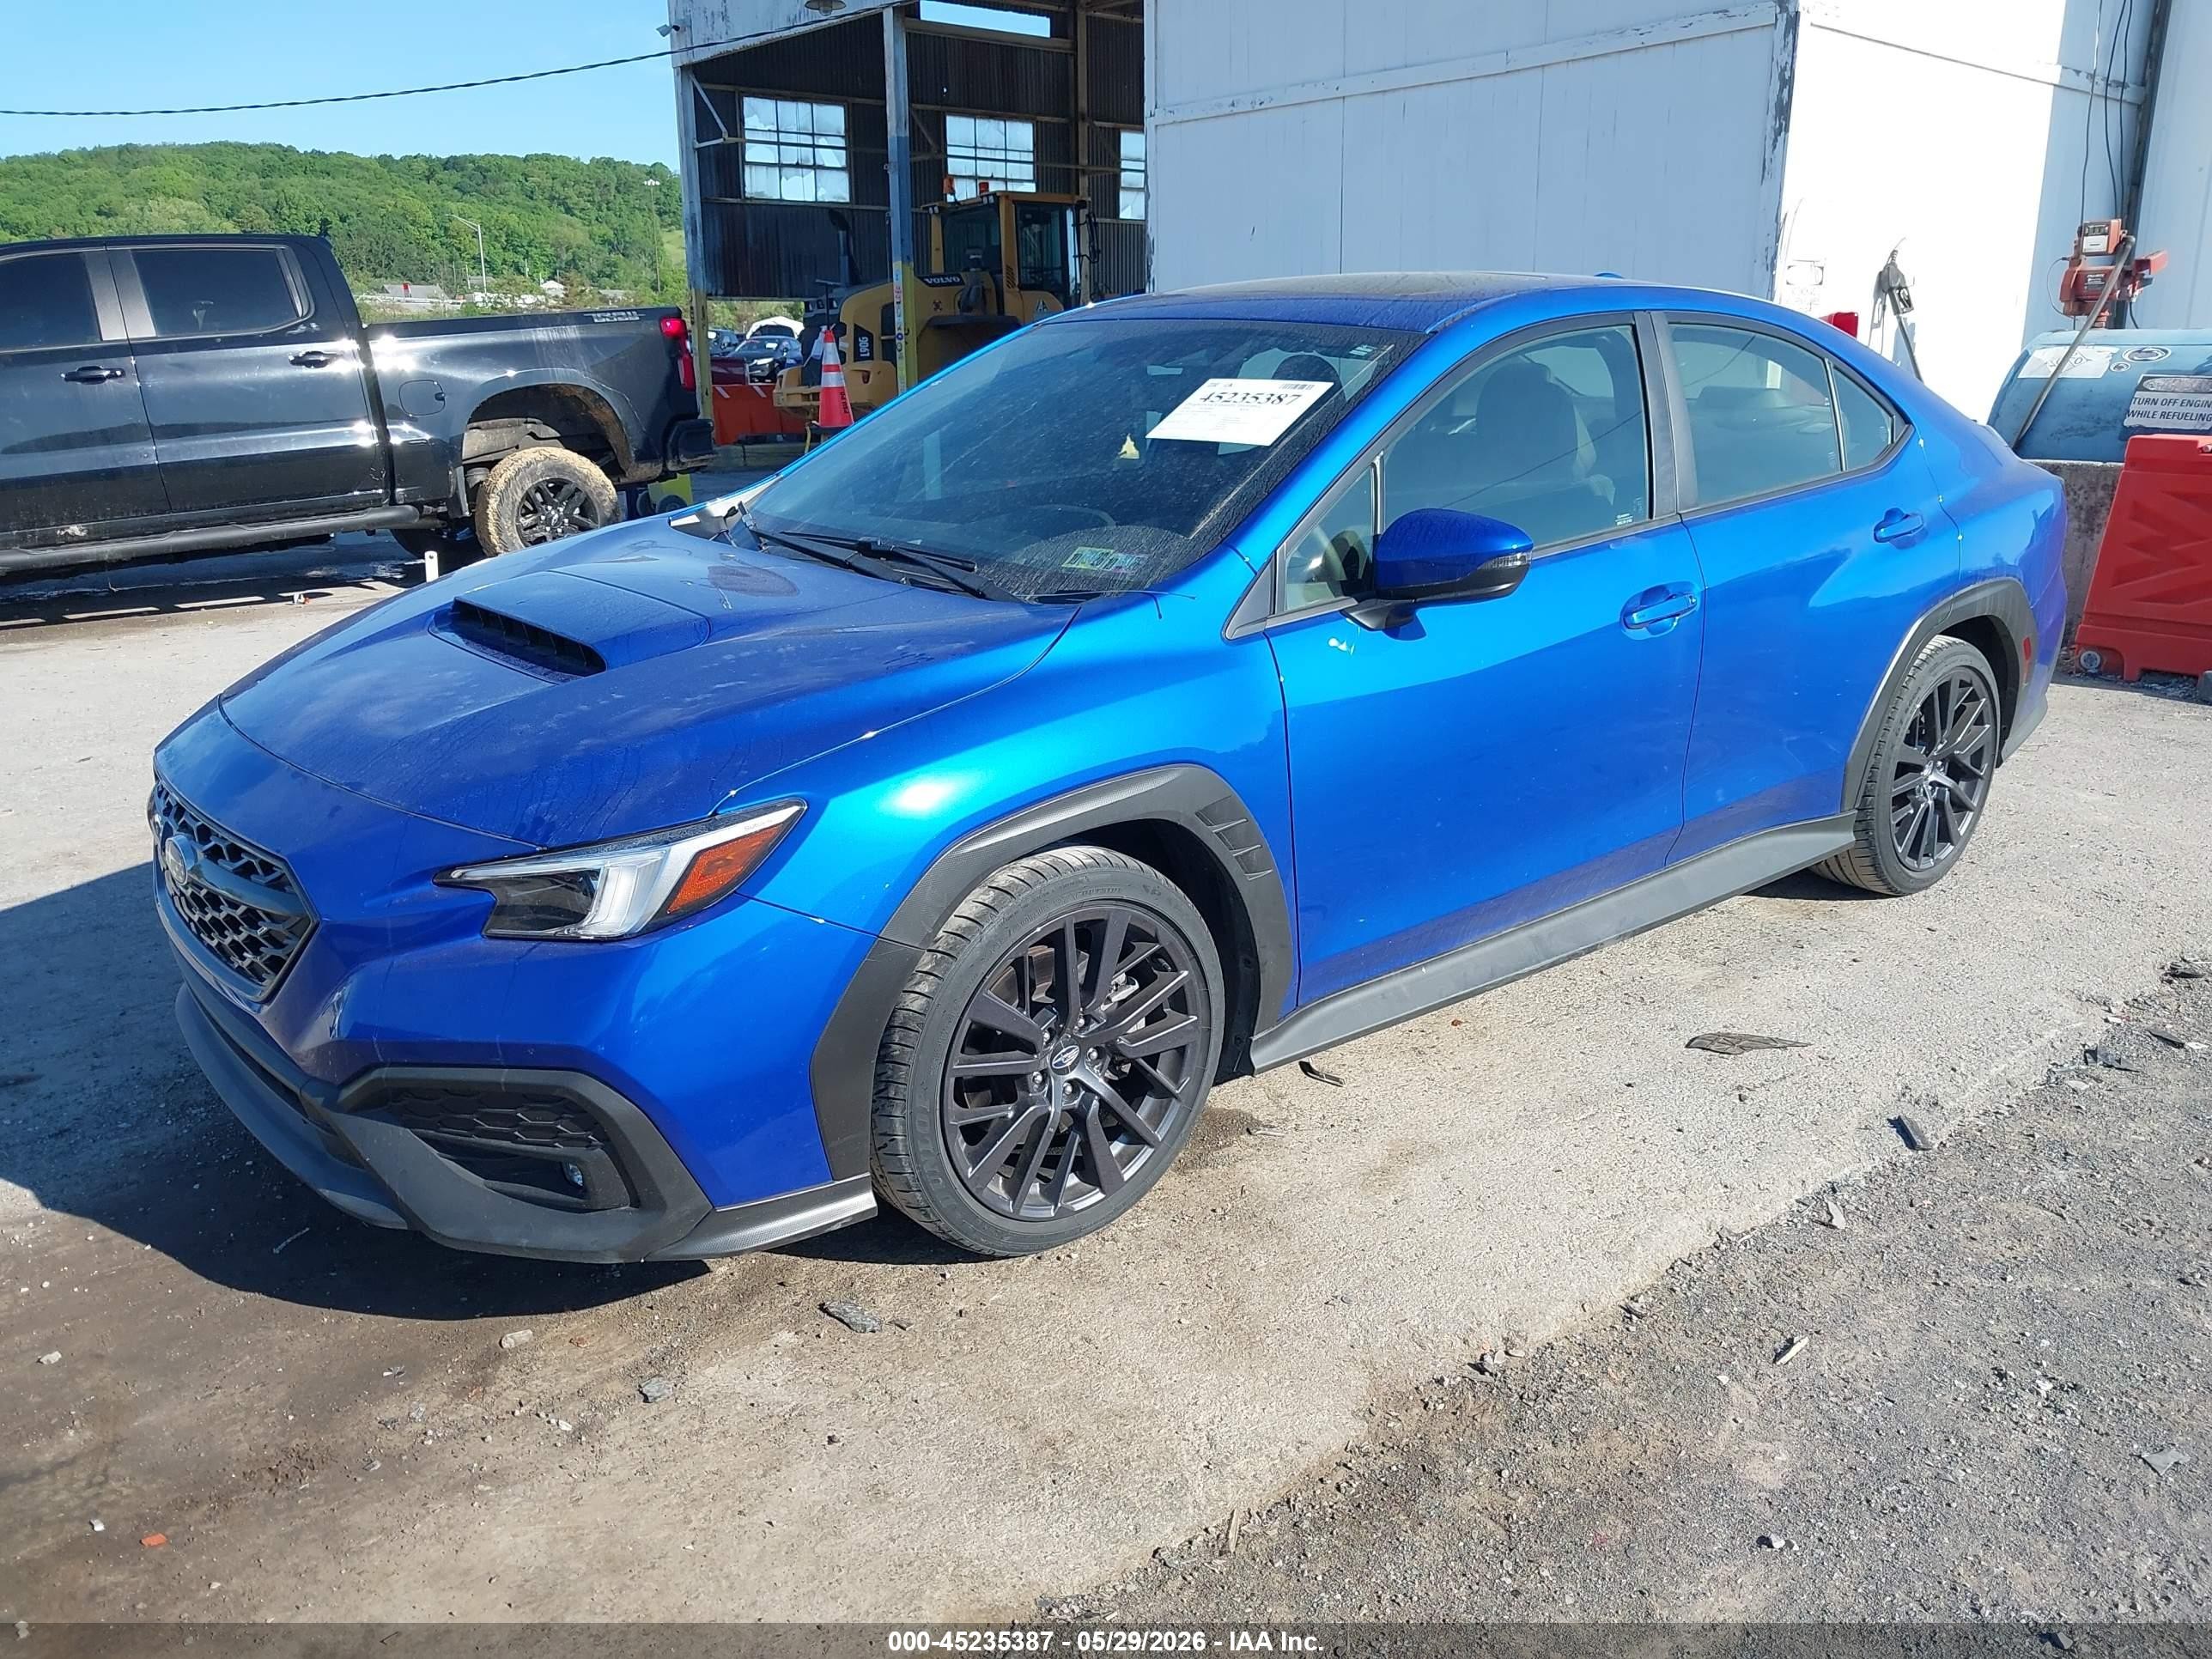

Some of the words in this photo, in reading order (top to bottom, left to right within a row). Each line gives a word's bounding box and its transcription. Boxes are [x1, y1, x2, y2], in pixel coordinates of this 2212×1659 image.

[924, 276, 960, 284] VOLVO
[859, 336, 869, 357] L90G
[1200, 392, 1302, 405] 45235387
[2132, 397, 2159, 406] TURN
[2160, 398, 2179, 407] OFF
[2179, 398, 2212, 408] ENGIN
[2127, 410, 2159, 419] WHILE
[2159, 411, 2212, 422] REFUELING
